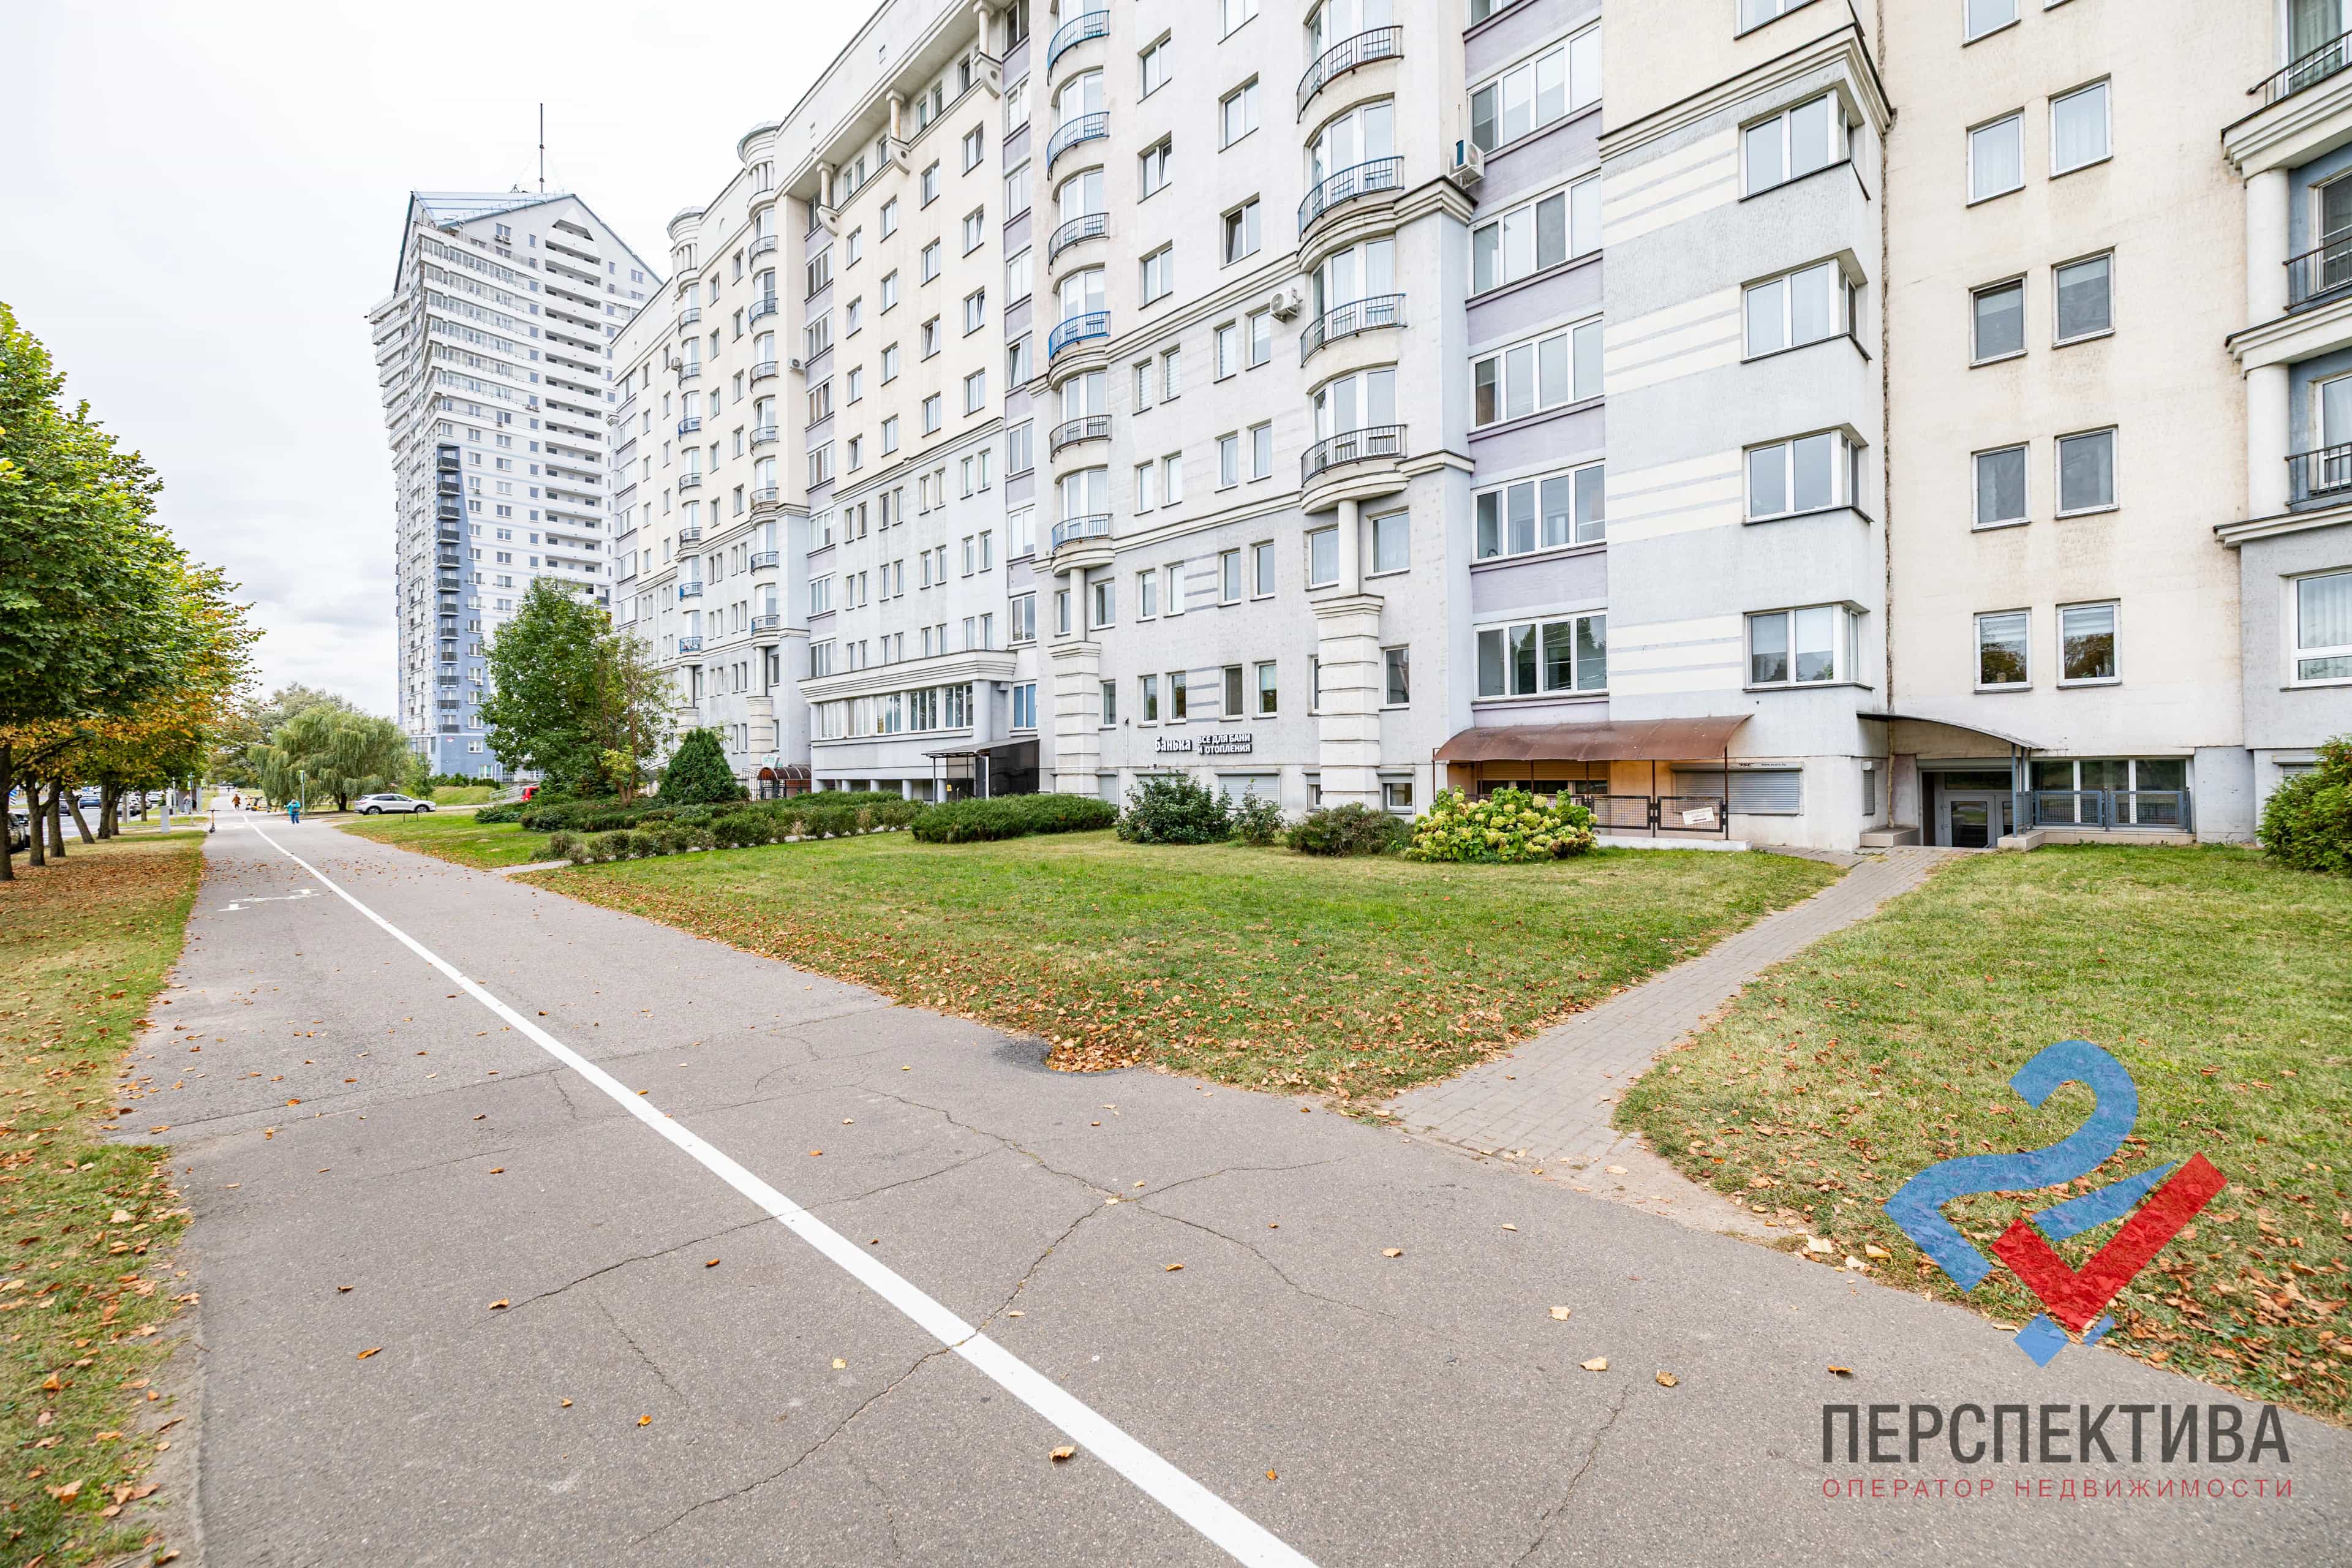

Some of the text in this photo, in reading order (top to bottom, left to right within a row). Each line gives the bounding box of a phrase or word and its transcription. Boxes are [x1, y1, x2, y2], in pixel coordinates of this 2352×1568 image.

[1197, 733, 1251, 744] ВСЕ ДЛЯ БАНИ
[1197, 744, 1251, 754] И ОТОПЛЕНИЯ
